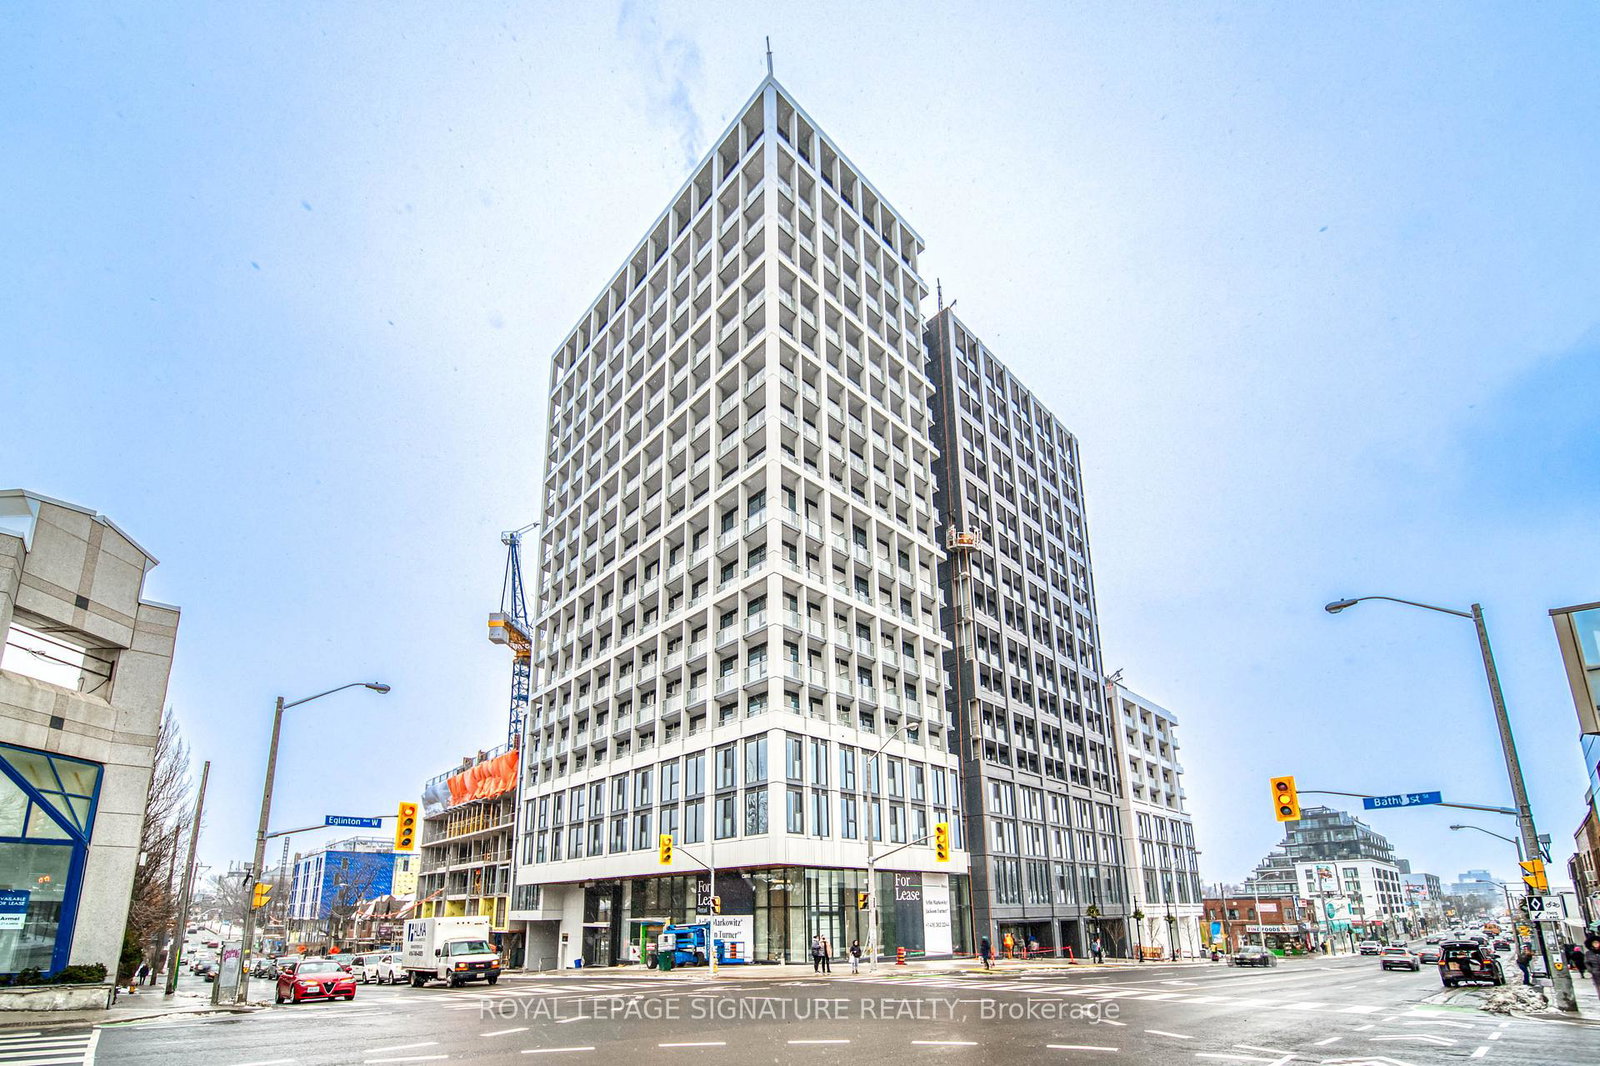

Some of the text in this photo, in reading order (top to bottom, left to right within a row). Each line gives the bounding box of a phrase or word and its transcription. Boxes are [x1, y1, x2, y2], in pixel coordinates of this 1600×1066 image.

[328, 816, 361, 826] Eglinton
[697, 880, 712, 893] For
[895, 873, 911, 887] For
[895, 887, 921, 901] Lease
